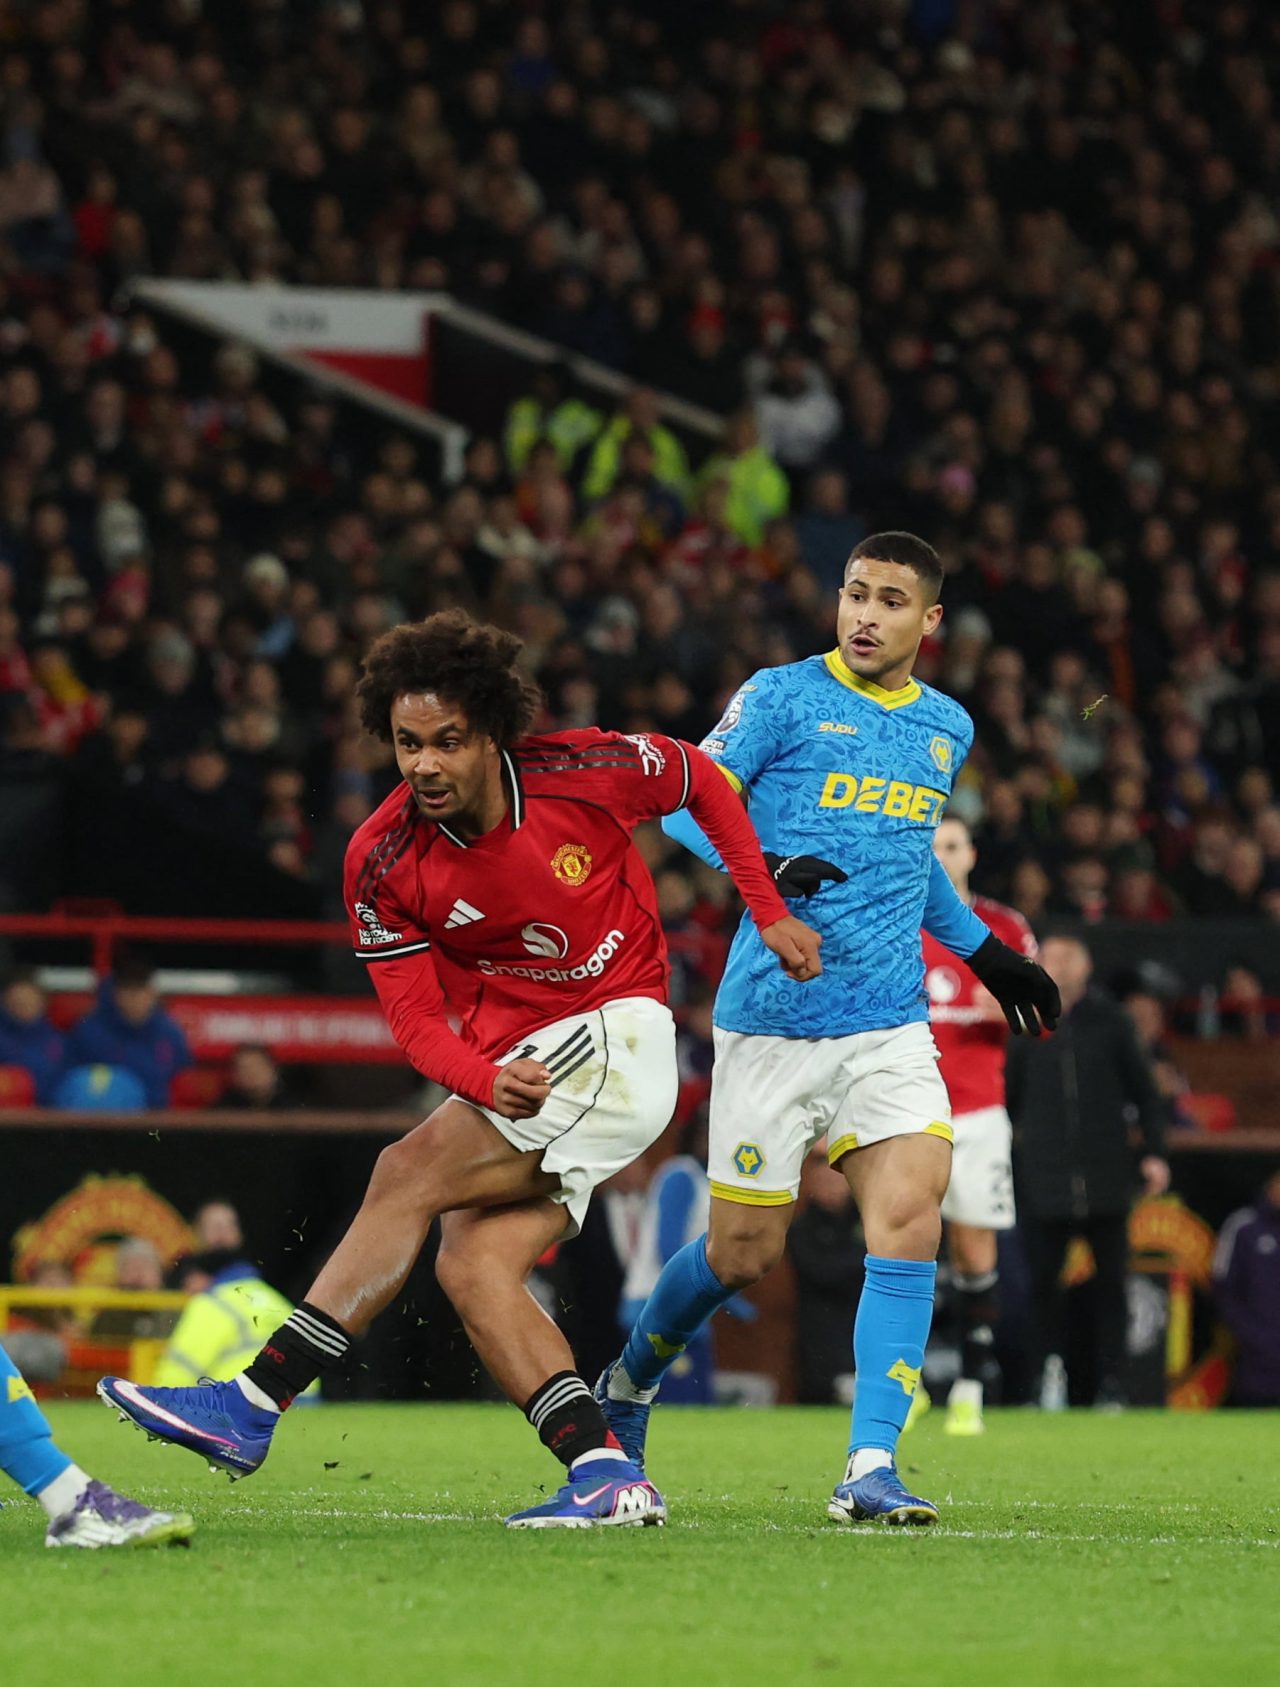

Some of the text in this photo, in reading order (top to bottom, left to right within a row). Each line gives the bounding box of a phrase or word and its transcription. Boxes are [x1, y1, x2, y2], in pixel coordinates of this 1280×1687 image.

[818, 721, 858, 735] SUDU
[818, 771, 947, 825] DEBET
[477, 929, 625, 982] Snapdragon
